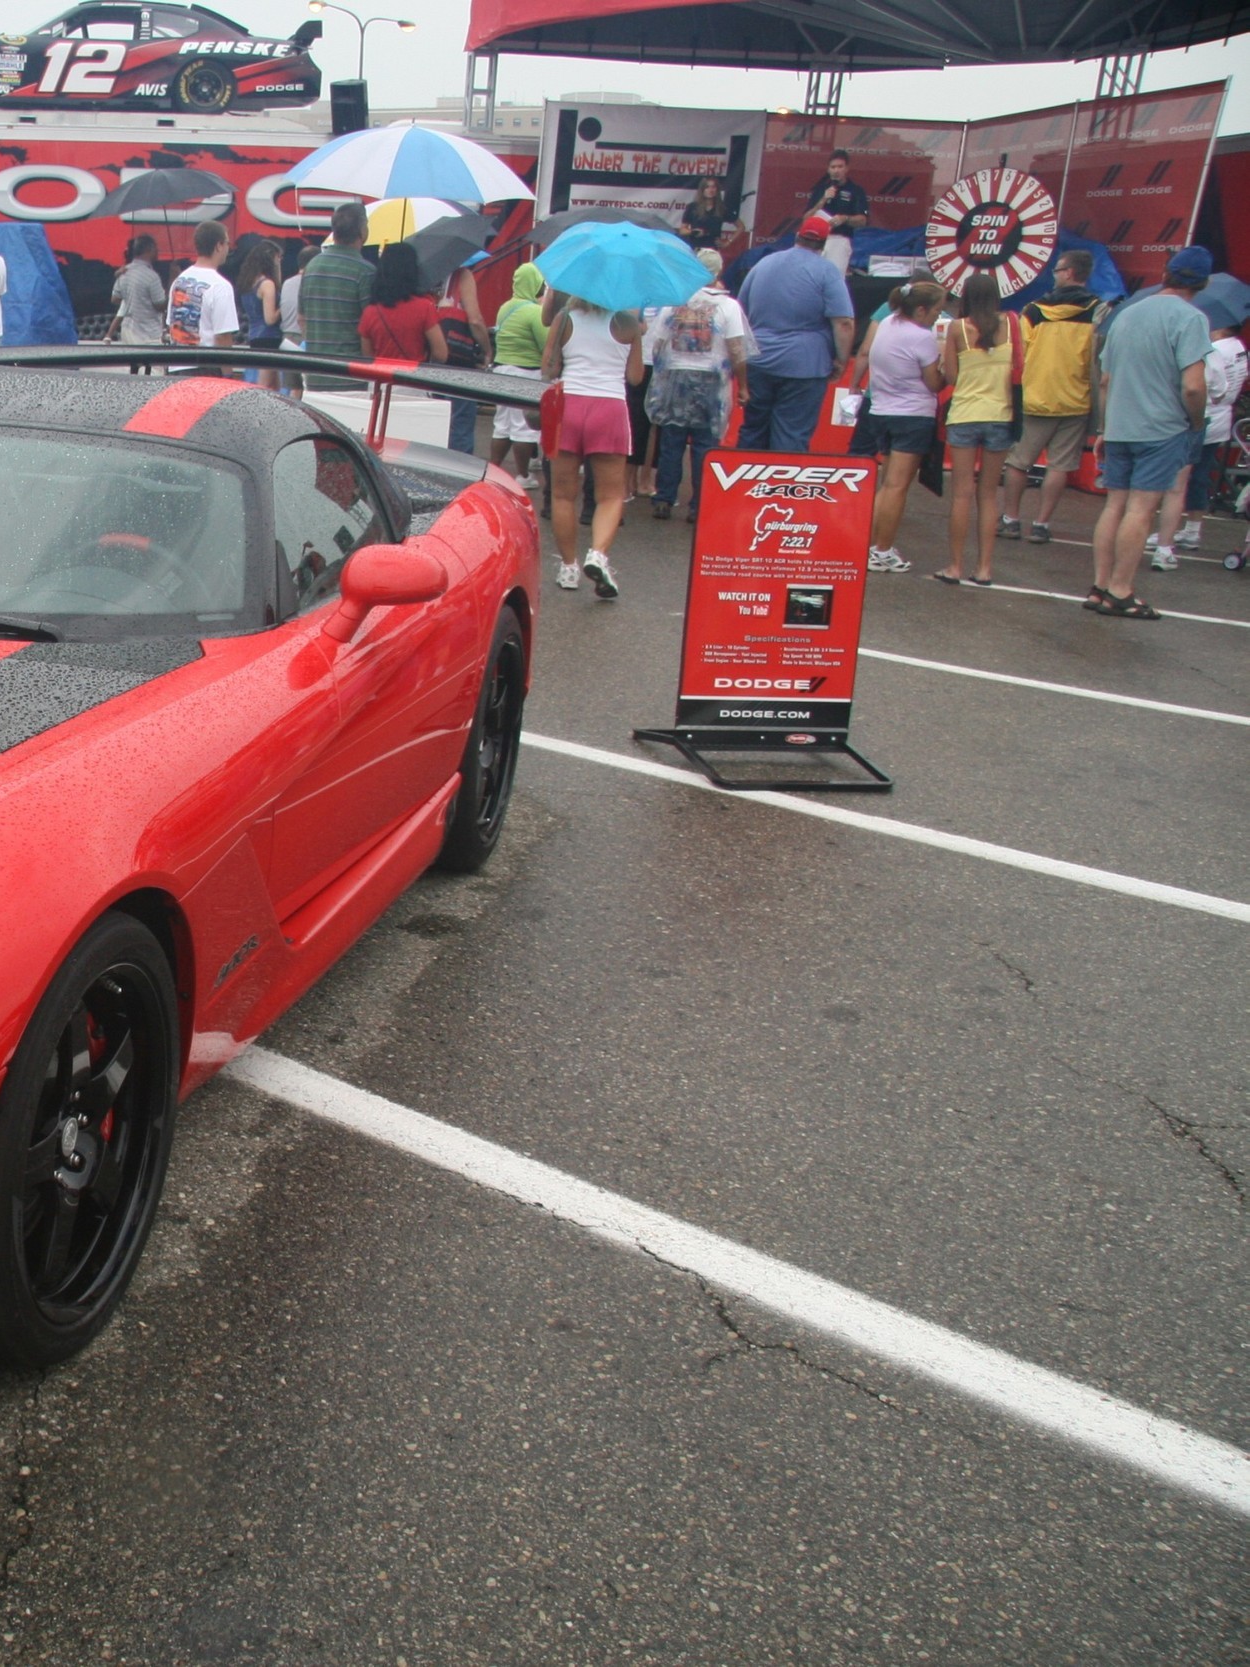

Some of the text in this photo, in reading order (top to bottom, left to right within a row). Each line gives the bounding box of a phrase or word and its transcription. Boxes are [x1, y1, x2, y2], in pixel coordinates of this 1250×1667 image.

[179, 41, 290, 57] PENSKE
[38, 42, 126, 93] 12
[135, 83, 168, 97] AVIS
[256, 83, 304, 92] DODGE
[1086, 186, 1172, 198] DODGE DODGE
[971, 214, 1009, 227] SPIN
[979, 229, 997, 241] TO
[970, 243, 1002, 255] WIN
[710, 462, 869, 492] VIPER
[768, 484, 837, 502] ACR
[764, 521, 818, 534] nürburgring
[780, 536, 813, 548] 7:22.1
[718, 591, 770, 602] WATCH IT ON
[739, 605, 769, 616] You Tube
[744, 634, 811, 643] Specifications
[713, 677, 811, 690] DODGE
[719, 709, 810, 719] DODGE.COM
